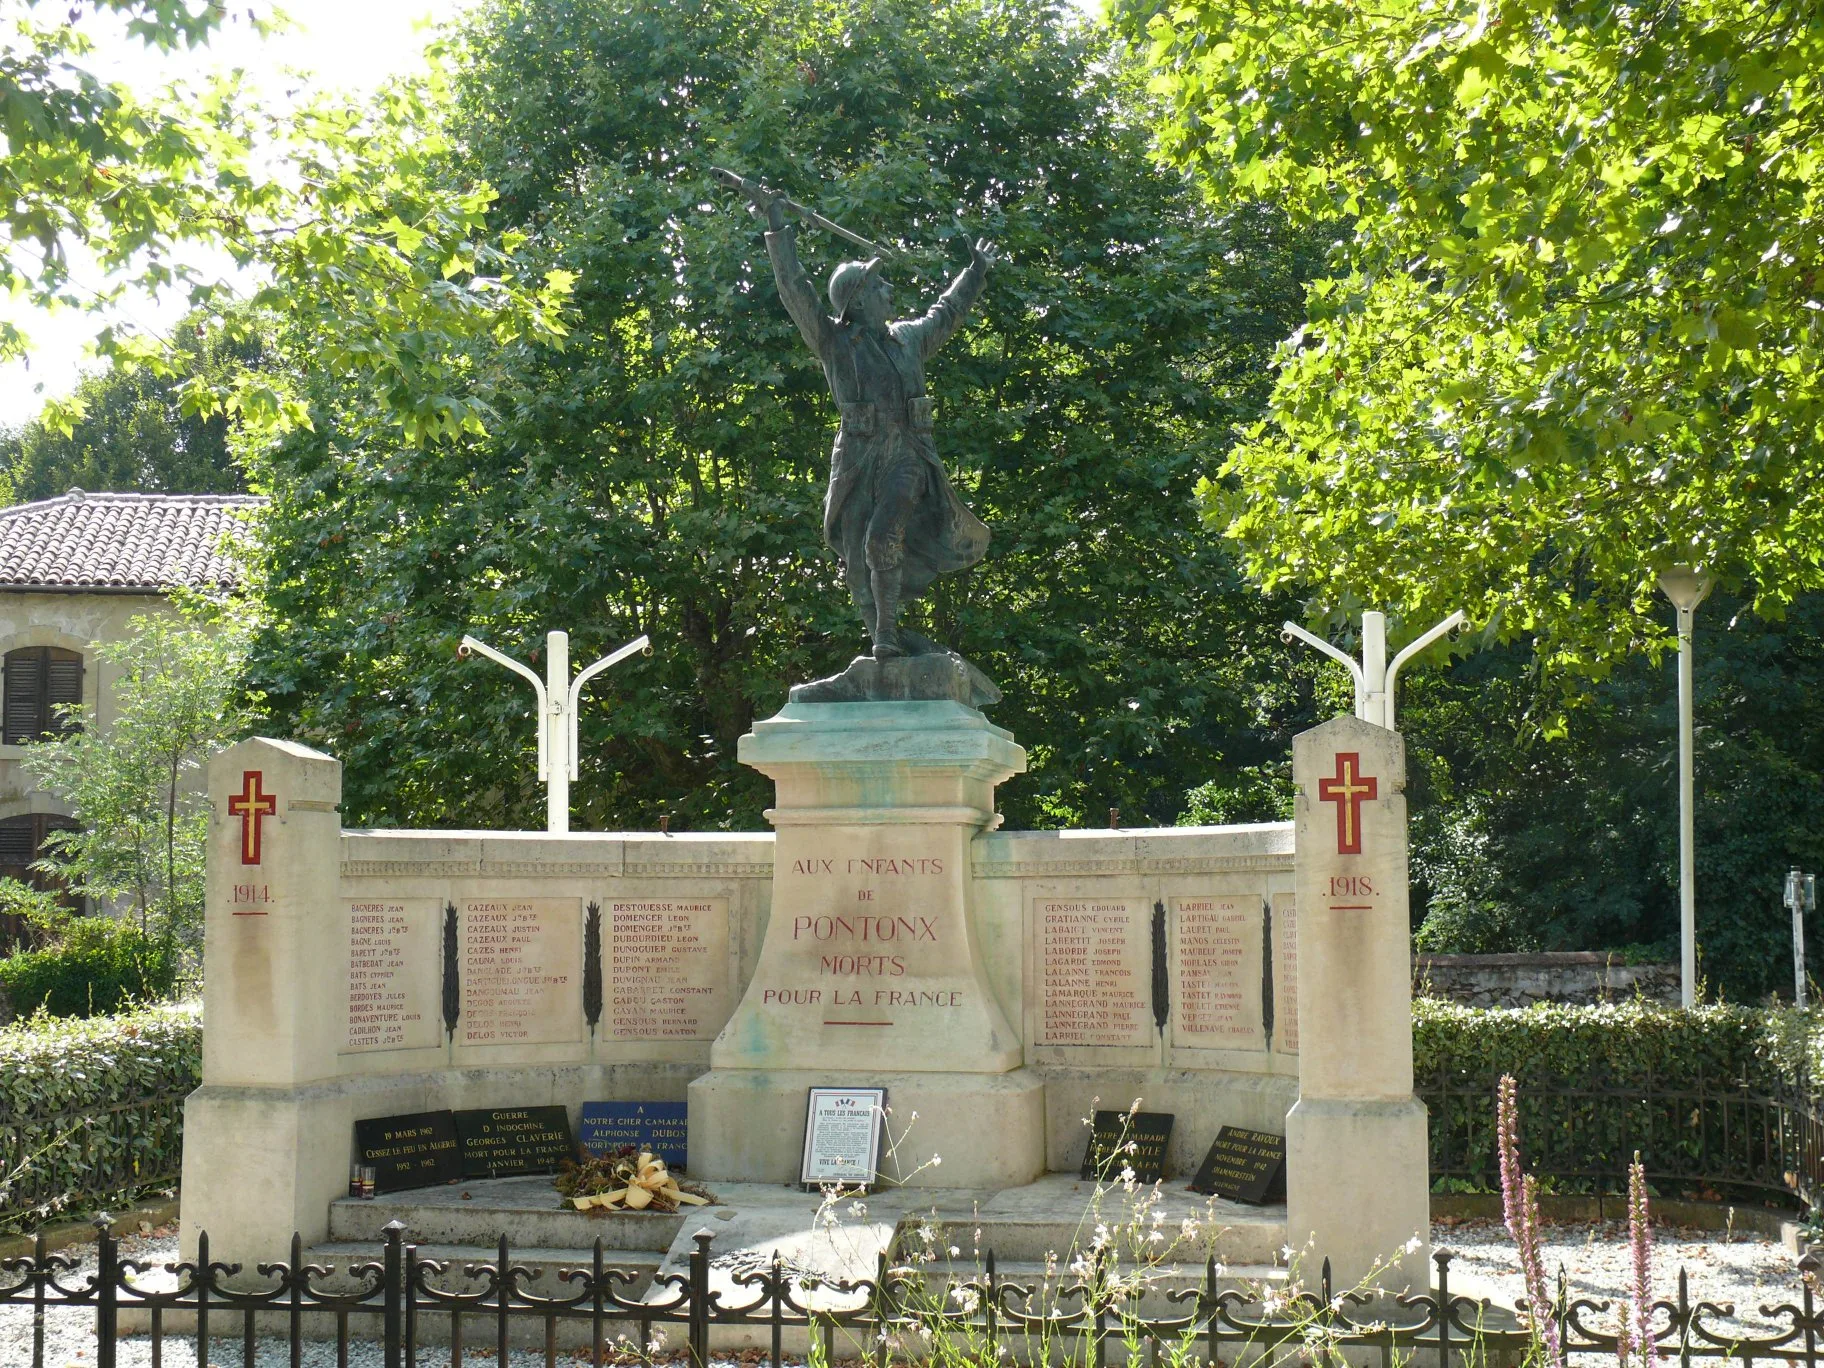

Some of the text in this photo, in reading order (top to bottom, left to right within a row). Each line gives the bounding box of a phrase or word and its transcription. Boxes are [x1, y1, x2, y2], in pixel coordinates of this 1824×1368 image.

[792, 859, 943, 874] AUX ENFANTS
[858, 890, 874, 900] DE
[1046, 915, 1098, 923] GRATIANNE
[794, 916, 938, 941] PONTONX
[821, 955, 905, 976] MORTS
[1046, 968, 1089, 976] LALANNE
[764, 990, 962, 1006] POUR LA FRANCE
[1046, 990, 1097, 998] LAMARQUE
[1182, 992, 1211, 1000] TASTET
[1046, 1000, 1107, 1008] LANNEGRAND
[350, 1014, 398, 1023] BONAVENTURE
[1046, 1011, 1108, 1019] LANNEGRAND
[637, 1106, 644, 1114] A
[492, 1112, 528, 1120] GUERRE
[497, 1123, 544, 1132] INDOCHINE
[384, 1127, 433, 1140] 19 MARS 1962
[466, 1132, 565, 1146] GEORGES CLAVERIE
[366, 1148, 391, 1158] CESSEZ
[392, 1147, 401, 1155] LE
[403, 1145, 416, 1154] FEU
[429, 1140, 457, 1150] ALGERIE
[464, 1150, 488, 1159] MORT
[493, 1148, 516, 1157] POUR
[536, 1145, 570, 1154] FRANCE
[486, 1159, 524, 1168] JANVIER
